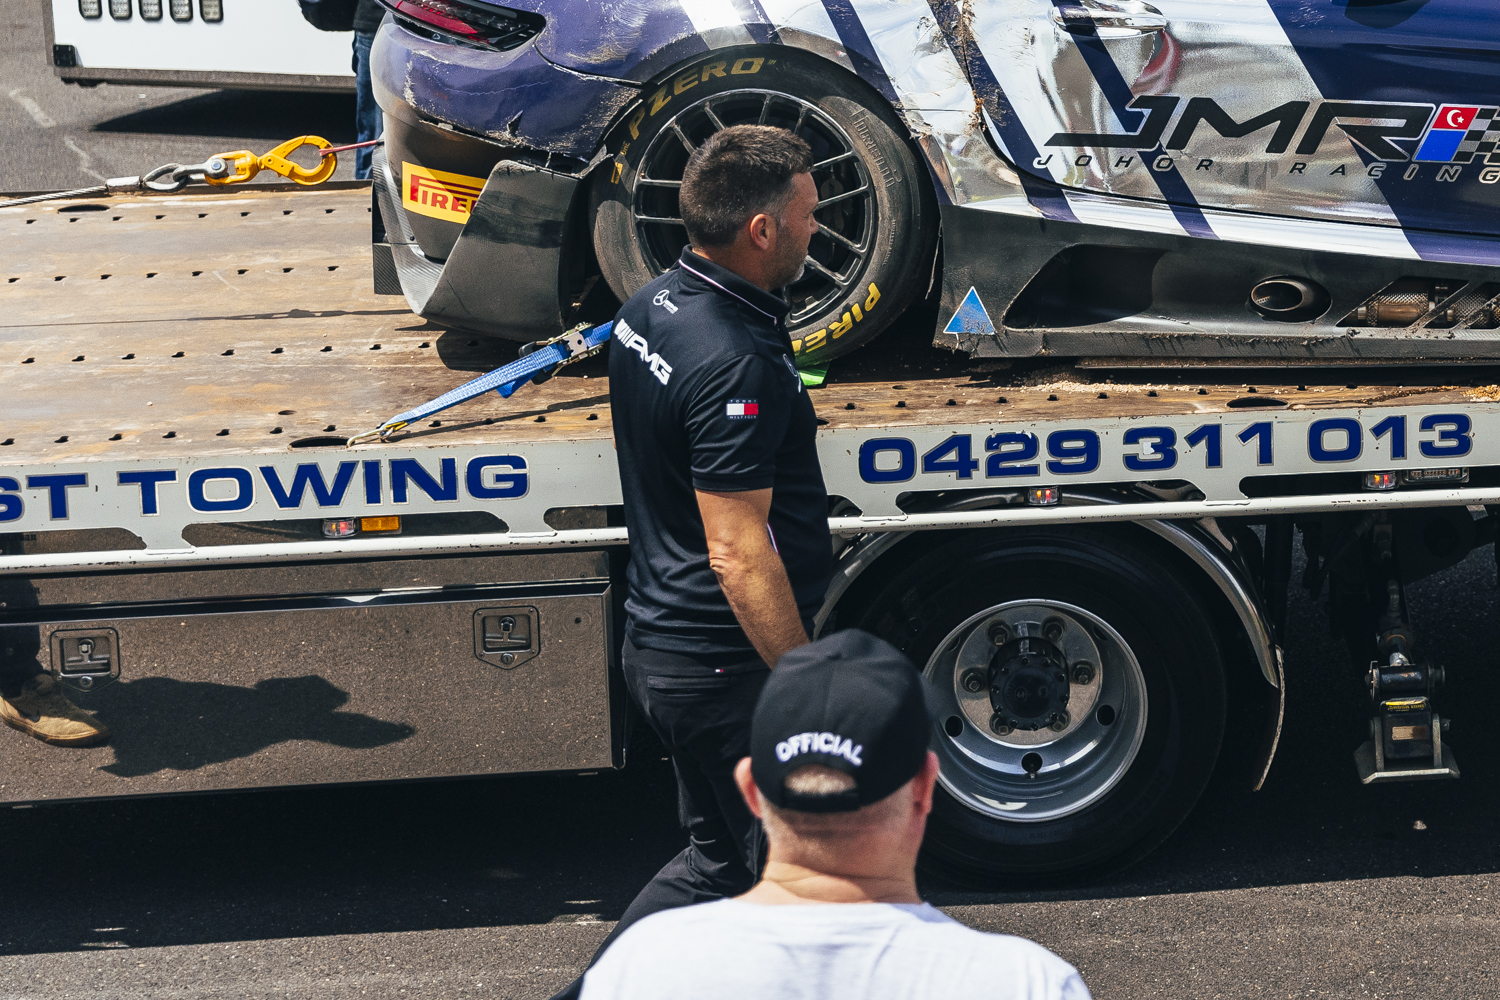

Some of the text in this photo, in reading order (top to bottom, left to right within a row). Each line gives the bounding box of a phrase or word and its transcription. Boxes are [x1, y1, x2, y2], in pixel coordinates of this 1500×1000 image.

[1044, 95, 1436, 163] JMR
[1033, 154, 1213, 173] JOHOR
[858, 412, 1474, 484] 0429 311 013
[116, 454, 530, 517] TOWING
[775, 732, 863, 767] OFFICIAL
